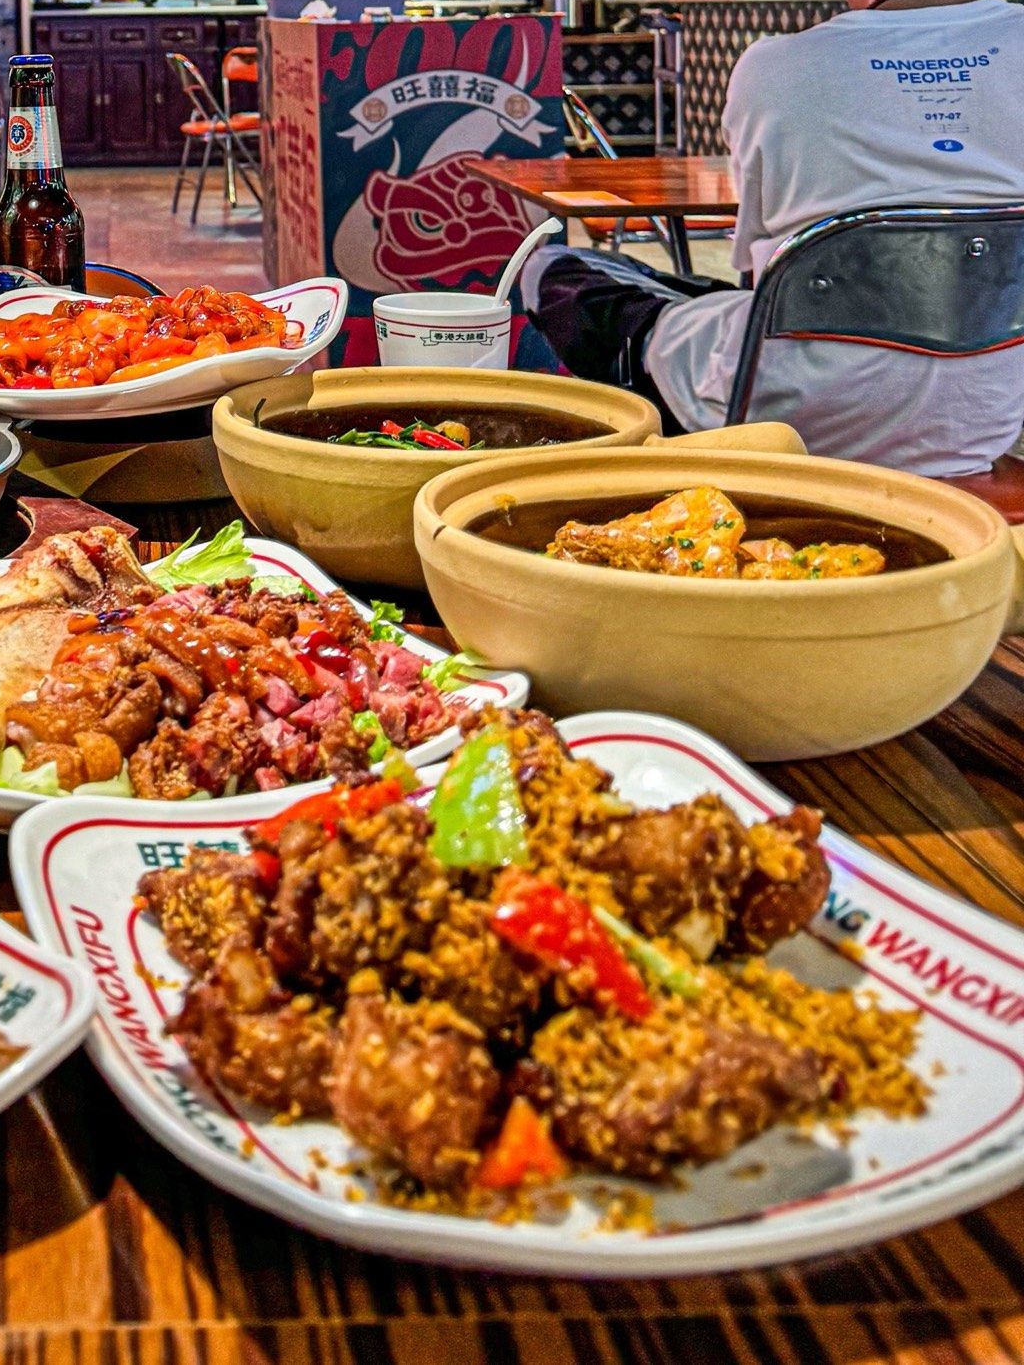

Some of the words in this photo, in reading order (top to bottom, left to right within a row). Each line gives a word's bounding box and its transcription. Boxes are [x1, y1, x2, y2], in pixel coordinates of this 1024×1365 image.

[870, 54, 990, 71] DANGEROUS
[897, 70, 972, 84] PEOPLE
[390, 74, 501, 107] 旺囍福
[70, 903, 170, 1070] WANGXIFU
